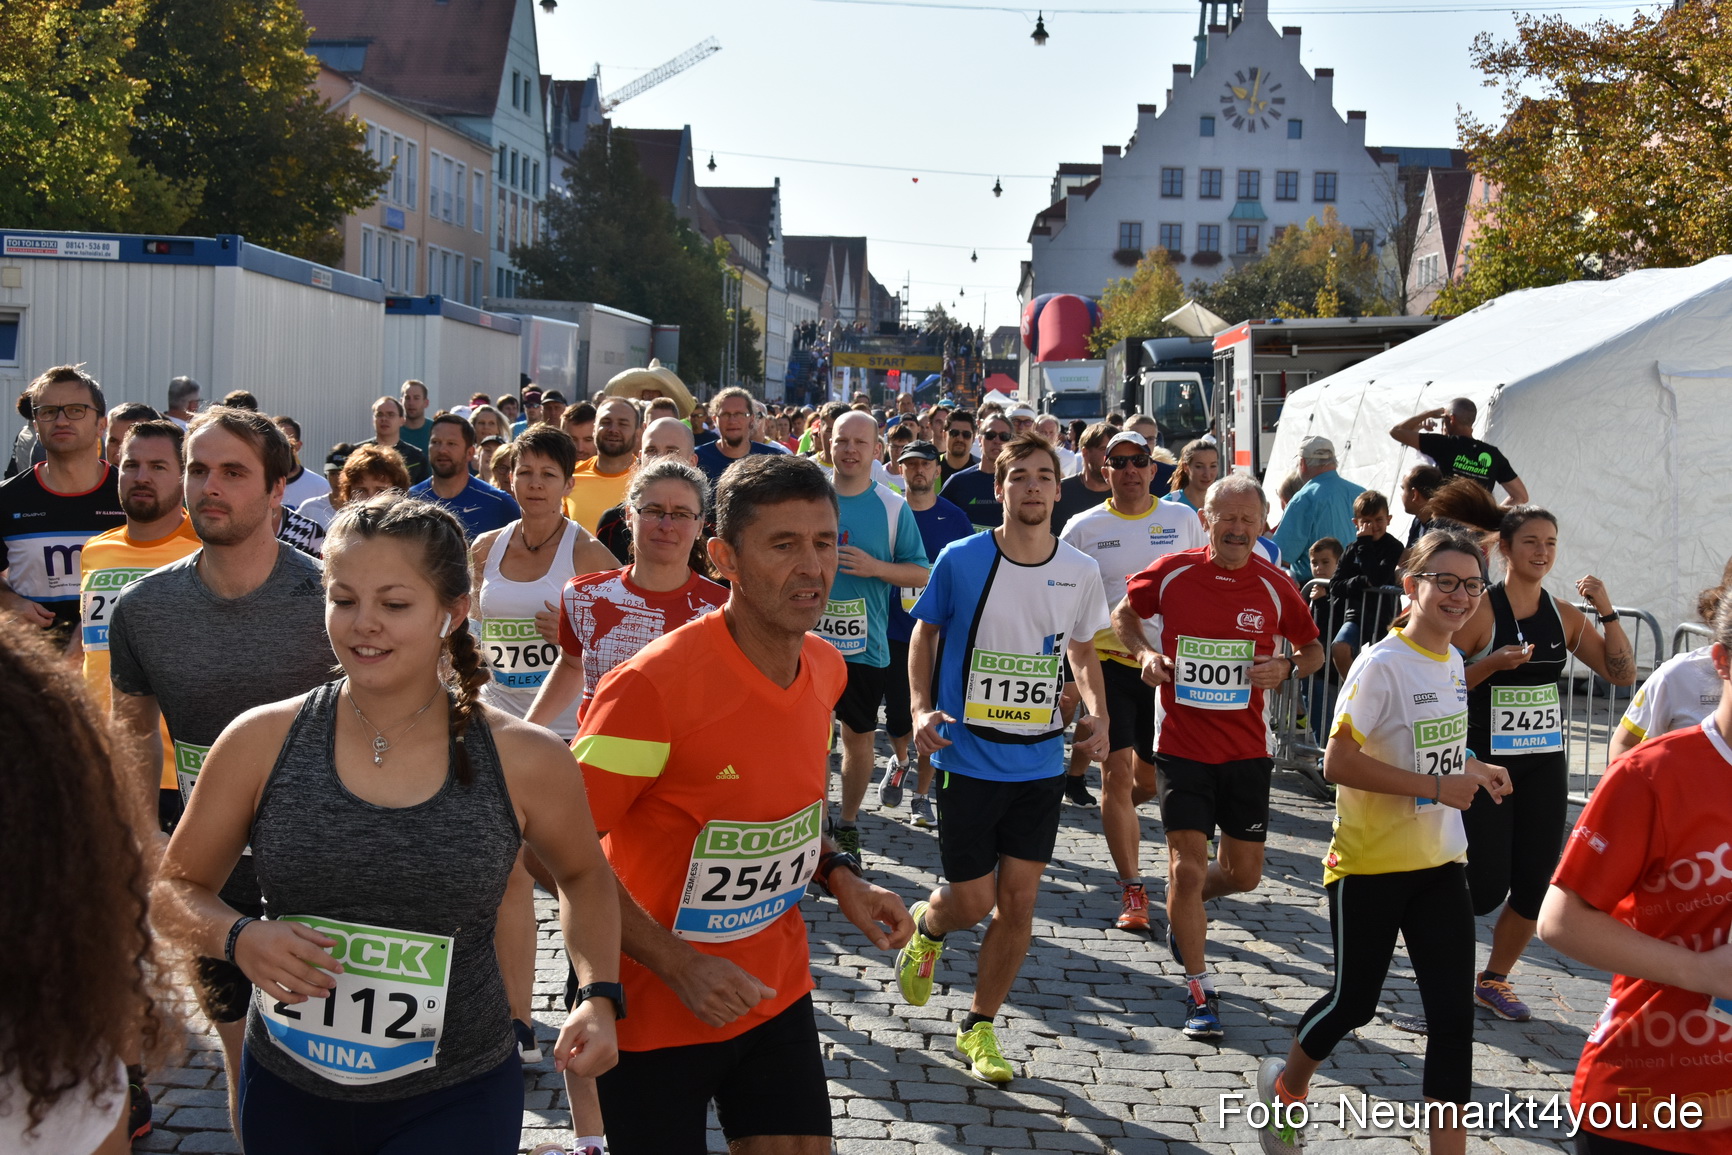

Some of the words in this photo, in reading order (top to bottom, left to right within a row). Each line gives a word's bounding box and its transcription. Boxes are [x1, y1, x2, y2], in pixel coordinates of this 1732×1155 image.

[868, 357, 906, 367] START
[1452, 461, 1488, 475] neumarkt
[1150, 526, 1163, 535] 20
[91, 595, 118, 620] 2
[486, 622, 542, 639] BOC
[490, 643, 559, 669] 2760
[1182, 640, 1248, 659] BOCK
[978, 653, 1052, 676] BOCK
[1183, 661, 1243, 686] 3001
[508, 675, 542, 685] ALEX
[980, 678, 1047, 704] 1136
[1189, 689, 1237, 702] RUDOLF
[1414, 693, 1437, 702] BOCK
[1497, 687, 1557, 705] BOCK
[987, 708, 1031, 721] LUKAS
[1501, 709, 1555, 731] 2425
[1512, 736, 1547, 747] MARIA
[705, 809, 814, 854] BOCK
[701, 852, 805, 902] 2541
[707, 899, 785, 929] RONALD
[308, 1040, 376, 1070] NINA
